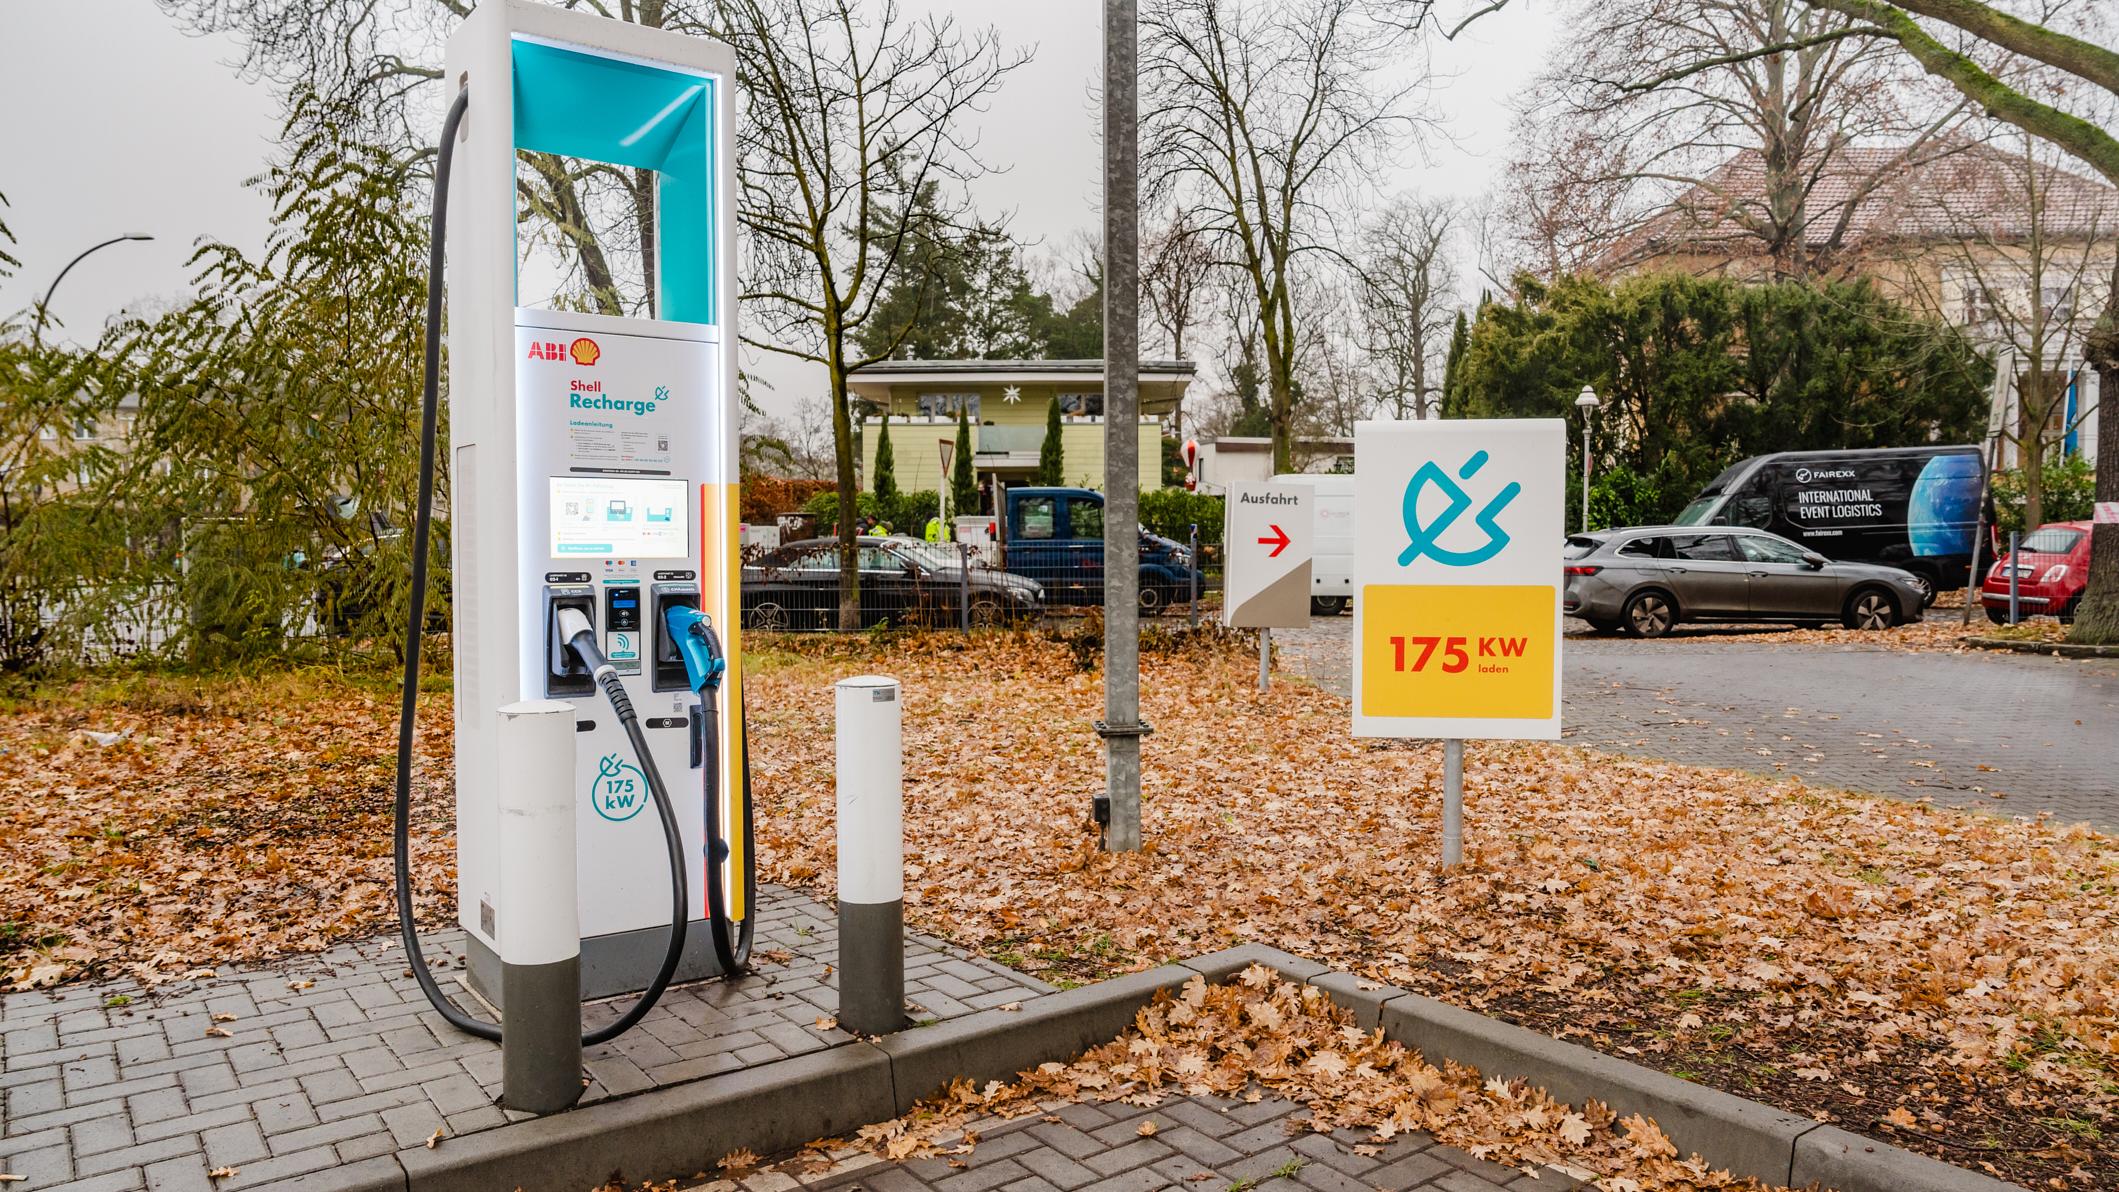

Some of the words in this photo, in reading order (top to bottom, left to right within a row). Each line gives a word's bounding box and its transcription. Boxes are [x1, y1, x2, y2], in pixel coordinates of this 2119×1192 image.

[570, 380, 601, 392] Shell
[570, 393, 656, 416] Recharge
[1813, 470, 1856, 479] FAIREXX
[1240, 492, 1299, 505] Ausfahrt
[1798, 489, 1874, 504] INTERNATIONAL
[1800, 506, 1830, 519] EVENT
[1832, 504, 1882, 518] LOGISTICS
[1390, 636, 1469, 674] 175
[1478, 637, 1528, 657] KW
[1478, 664, 1509, 674] laden
[606, 779, 634, 794] 175
[605, 794, 635, 809] kW
